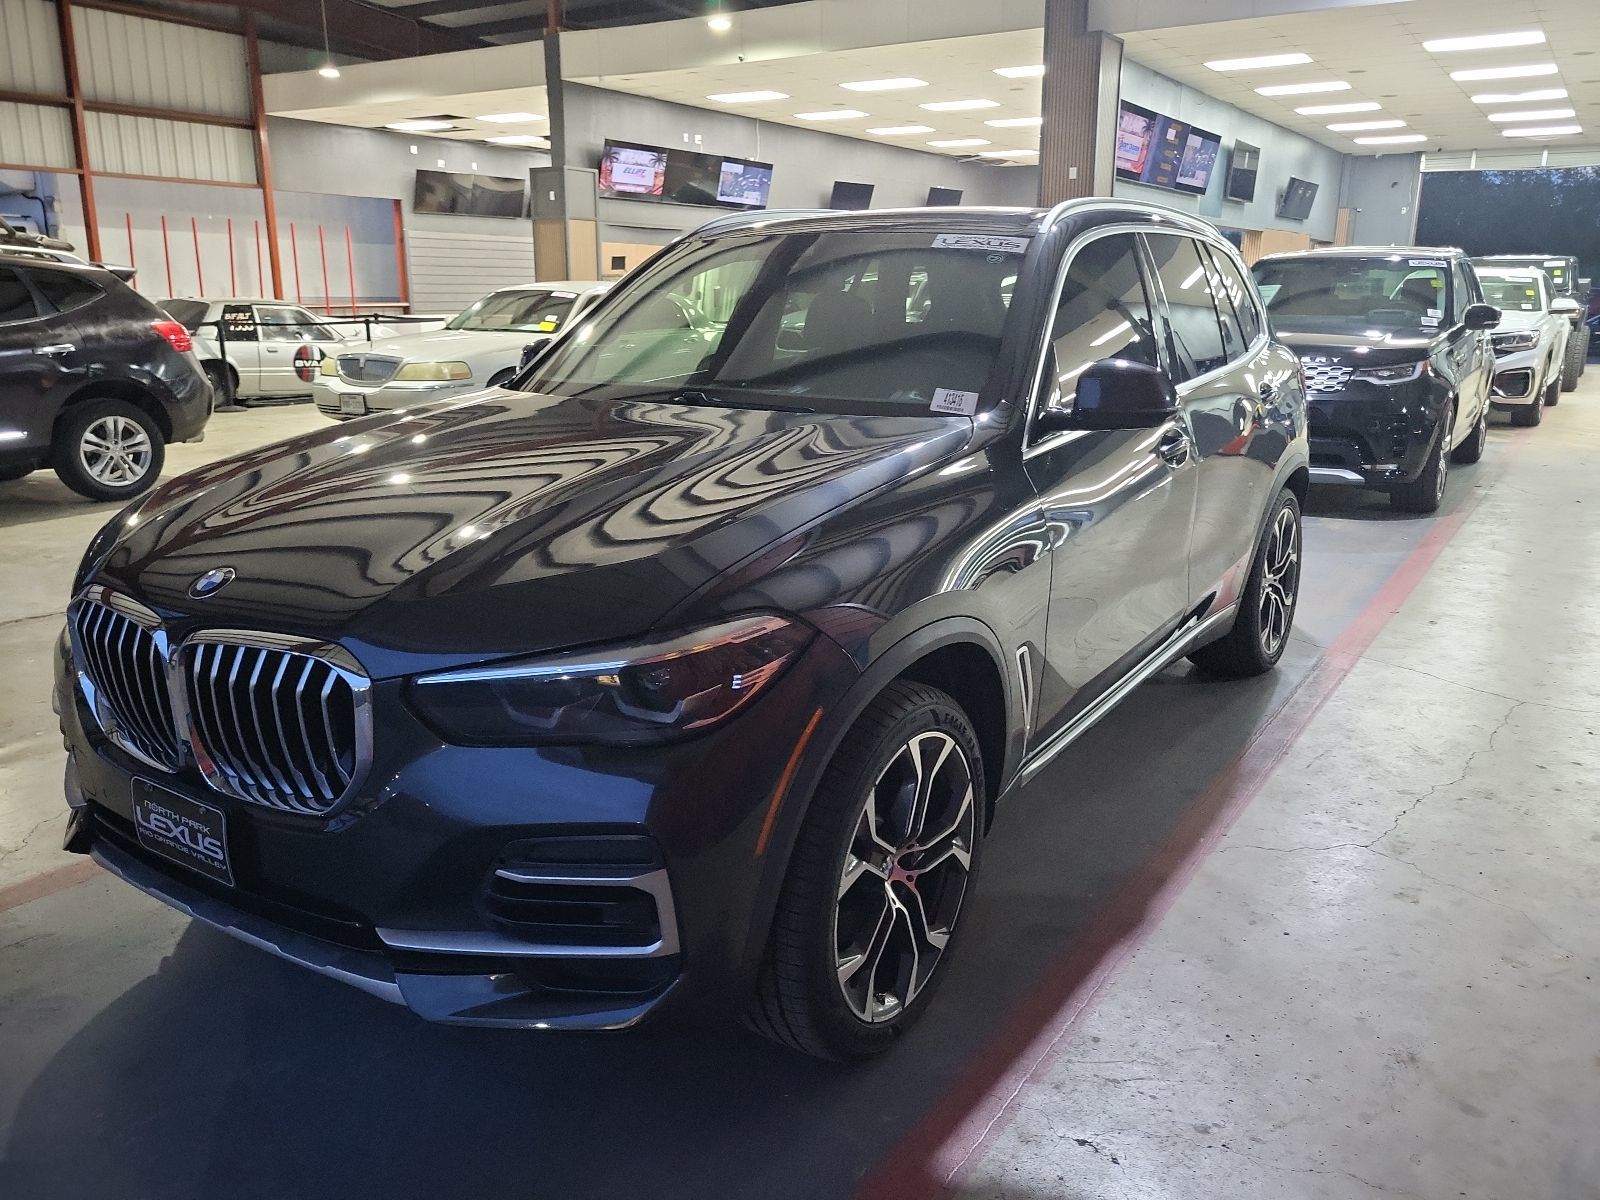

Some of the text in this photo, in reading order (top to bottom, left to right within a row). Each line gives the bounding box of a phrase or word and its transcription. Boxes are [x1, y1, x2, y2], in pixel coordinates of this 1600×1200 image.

[941, 238, 1021, 249] LEXUS
[143, 799, 211, 835] NORTH PARK
[136, 804, 224, 861] LEXUS
[190, 849, 226, 870] VALLEY
